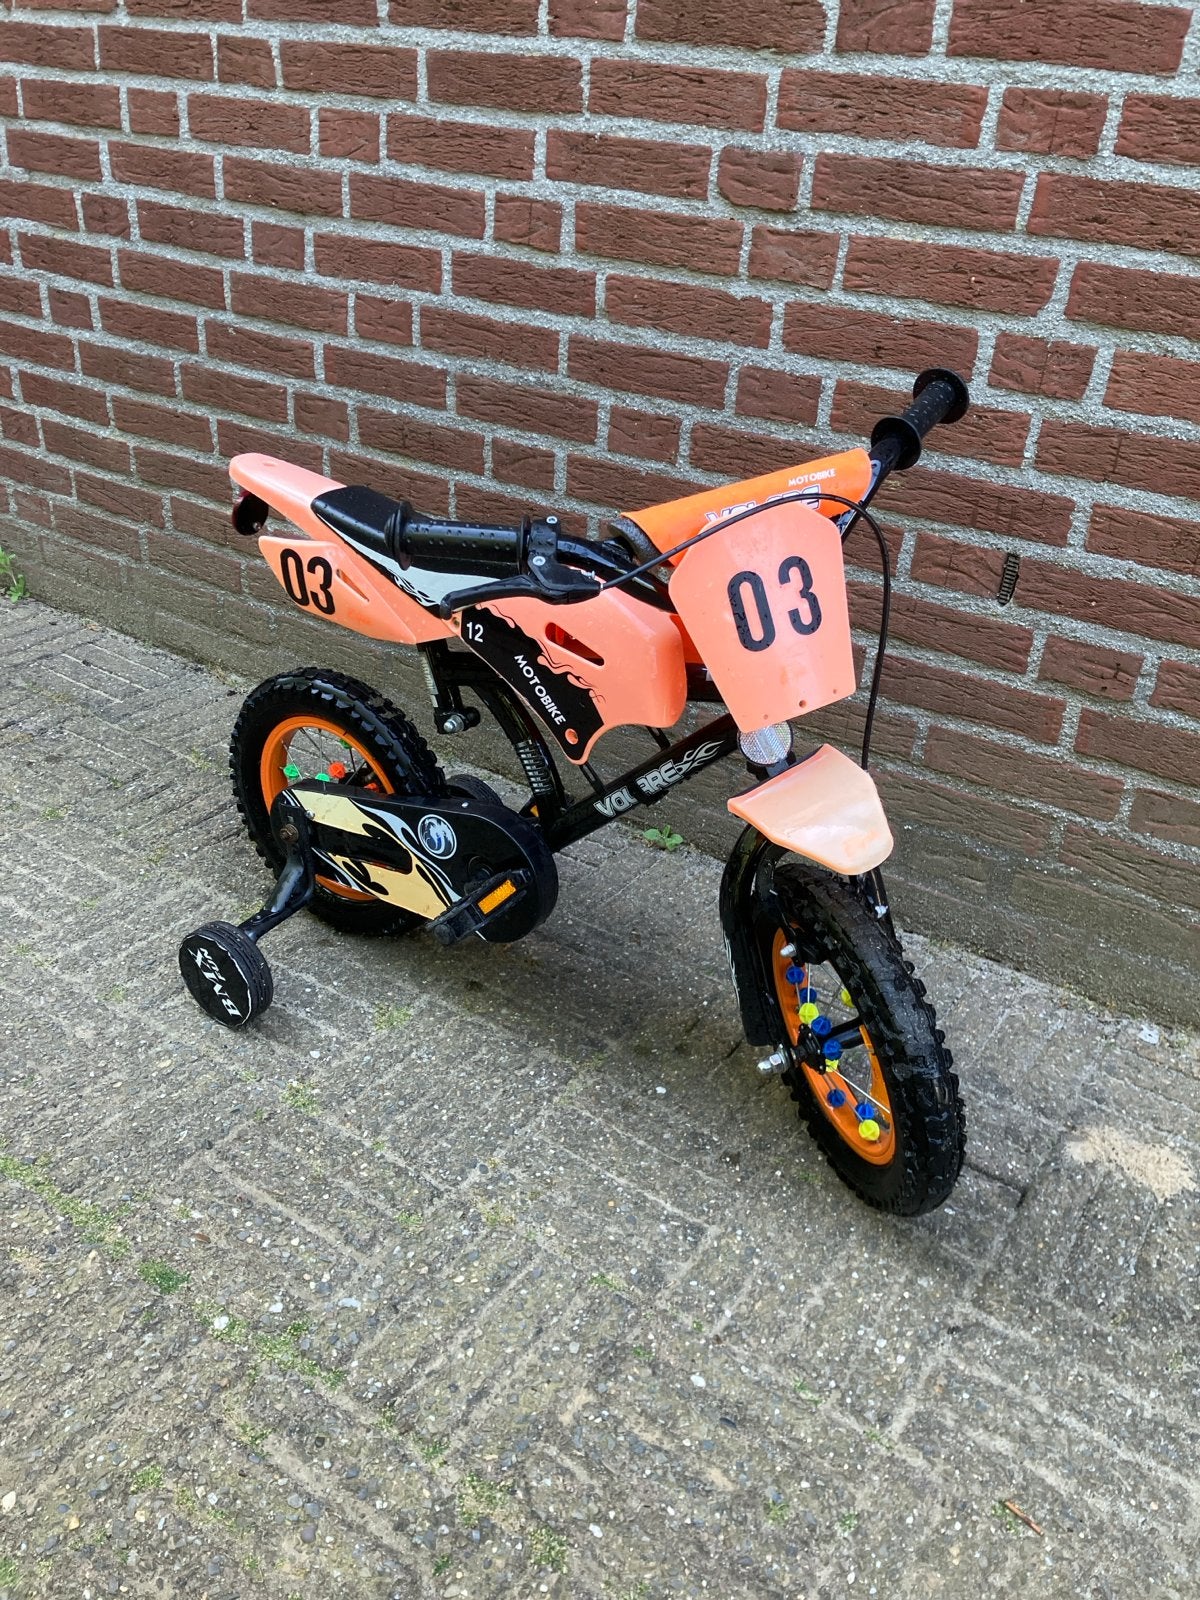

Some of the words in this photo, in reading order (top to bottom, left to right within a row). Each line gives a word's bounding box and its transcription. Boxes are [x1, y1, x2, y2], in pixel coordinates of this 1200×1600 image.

[788, 468, 836, 487] MOTOBIKE
[280, 548, 336, 616] 03
[727, 556, 822, 653] 03
[467, 621, 484, 643] 12
[514, 655, 566, 726] MOTOBIKE
[187, 948, 242, 1017] BMX
